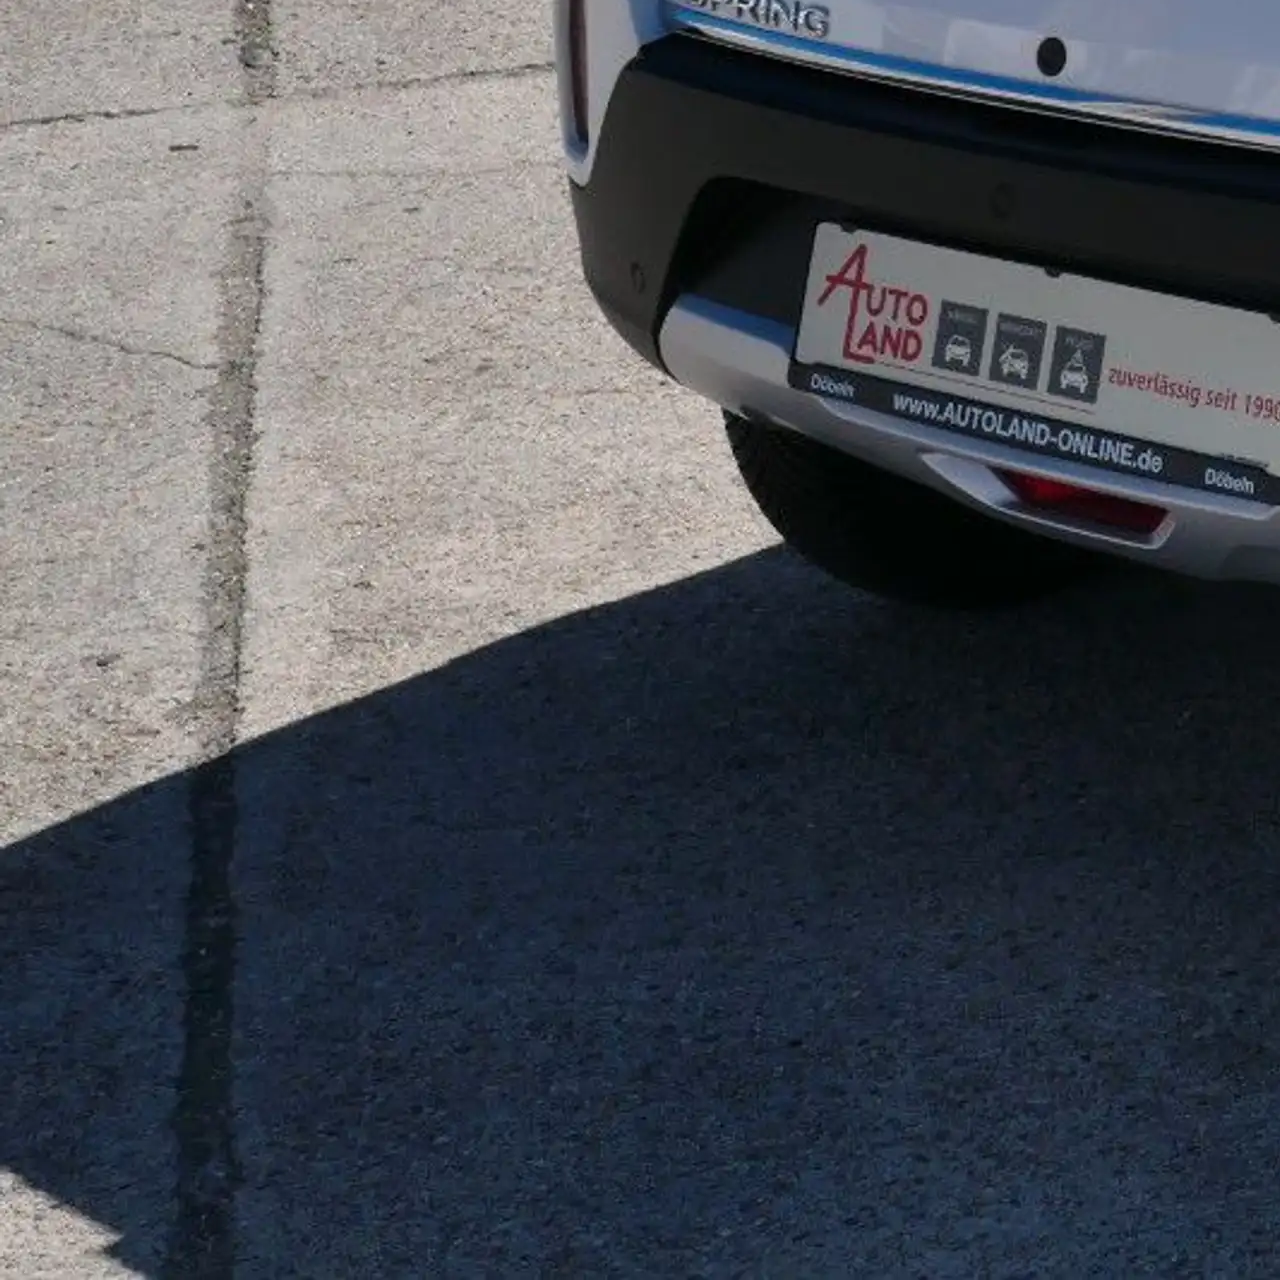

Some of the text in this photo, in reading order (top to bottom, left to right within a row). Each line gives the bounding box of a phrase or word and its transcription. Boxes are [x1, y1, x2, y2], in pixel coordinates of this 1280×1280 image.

[817, 243, 928, 326] AUTO
[843, 318, 922, 364] LAND
[1108, 368, 1201, 407] zuverlässig
[1205, 388, 1238, 411] seit
[892, 394, 1164, 473] www.AUTOLAND-ONLINE.de
[1204, 467, 1255, 494] Döbeln
